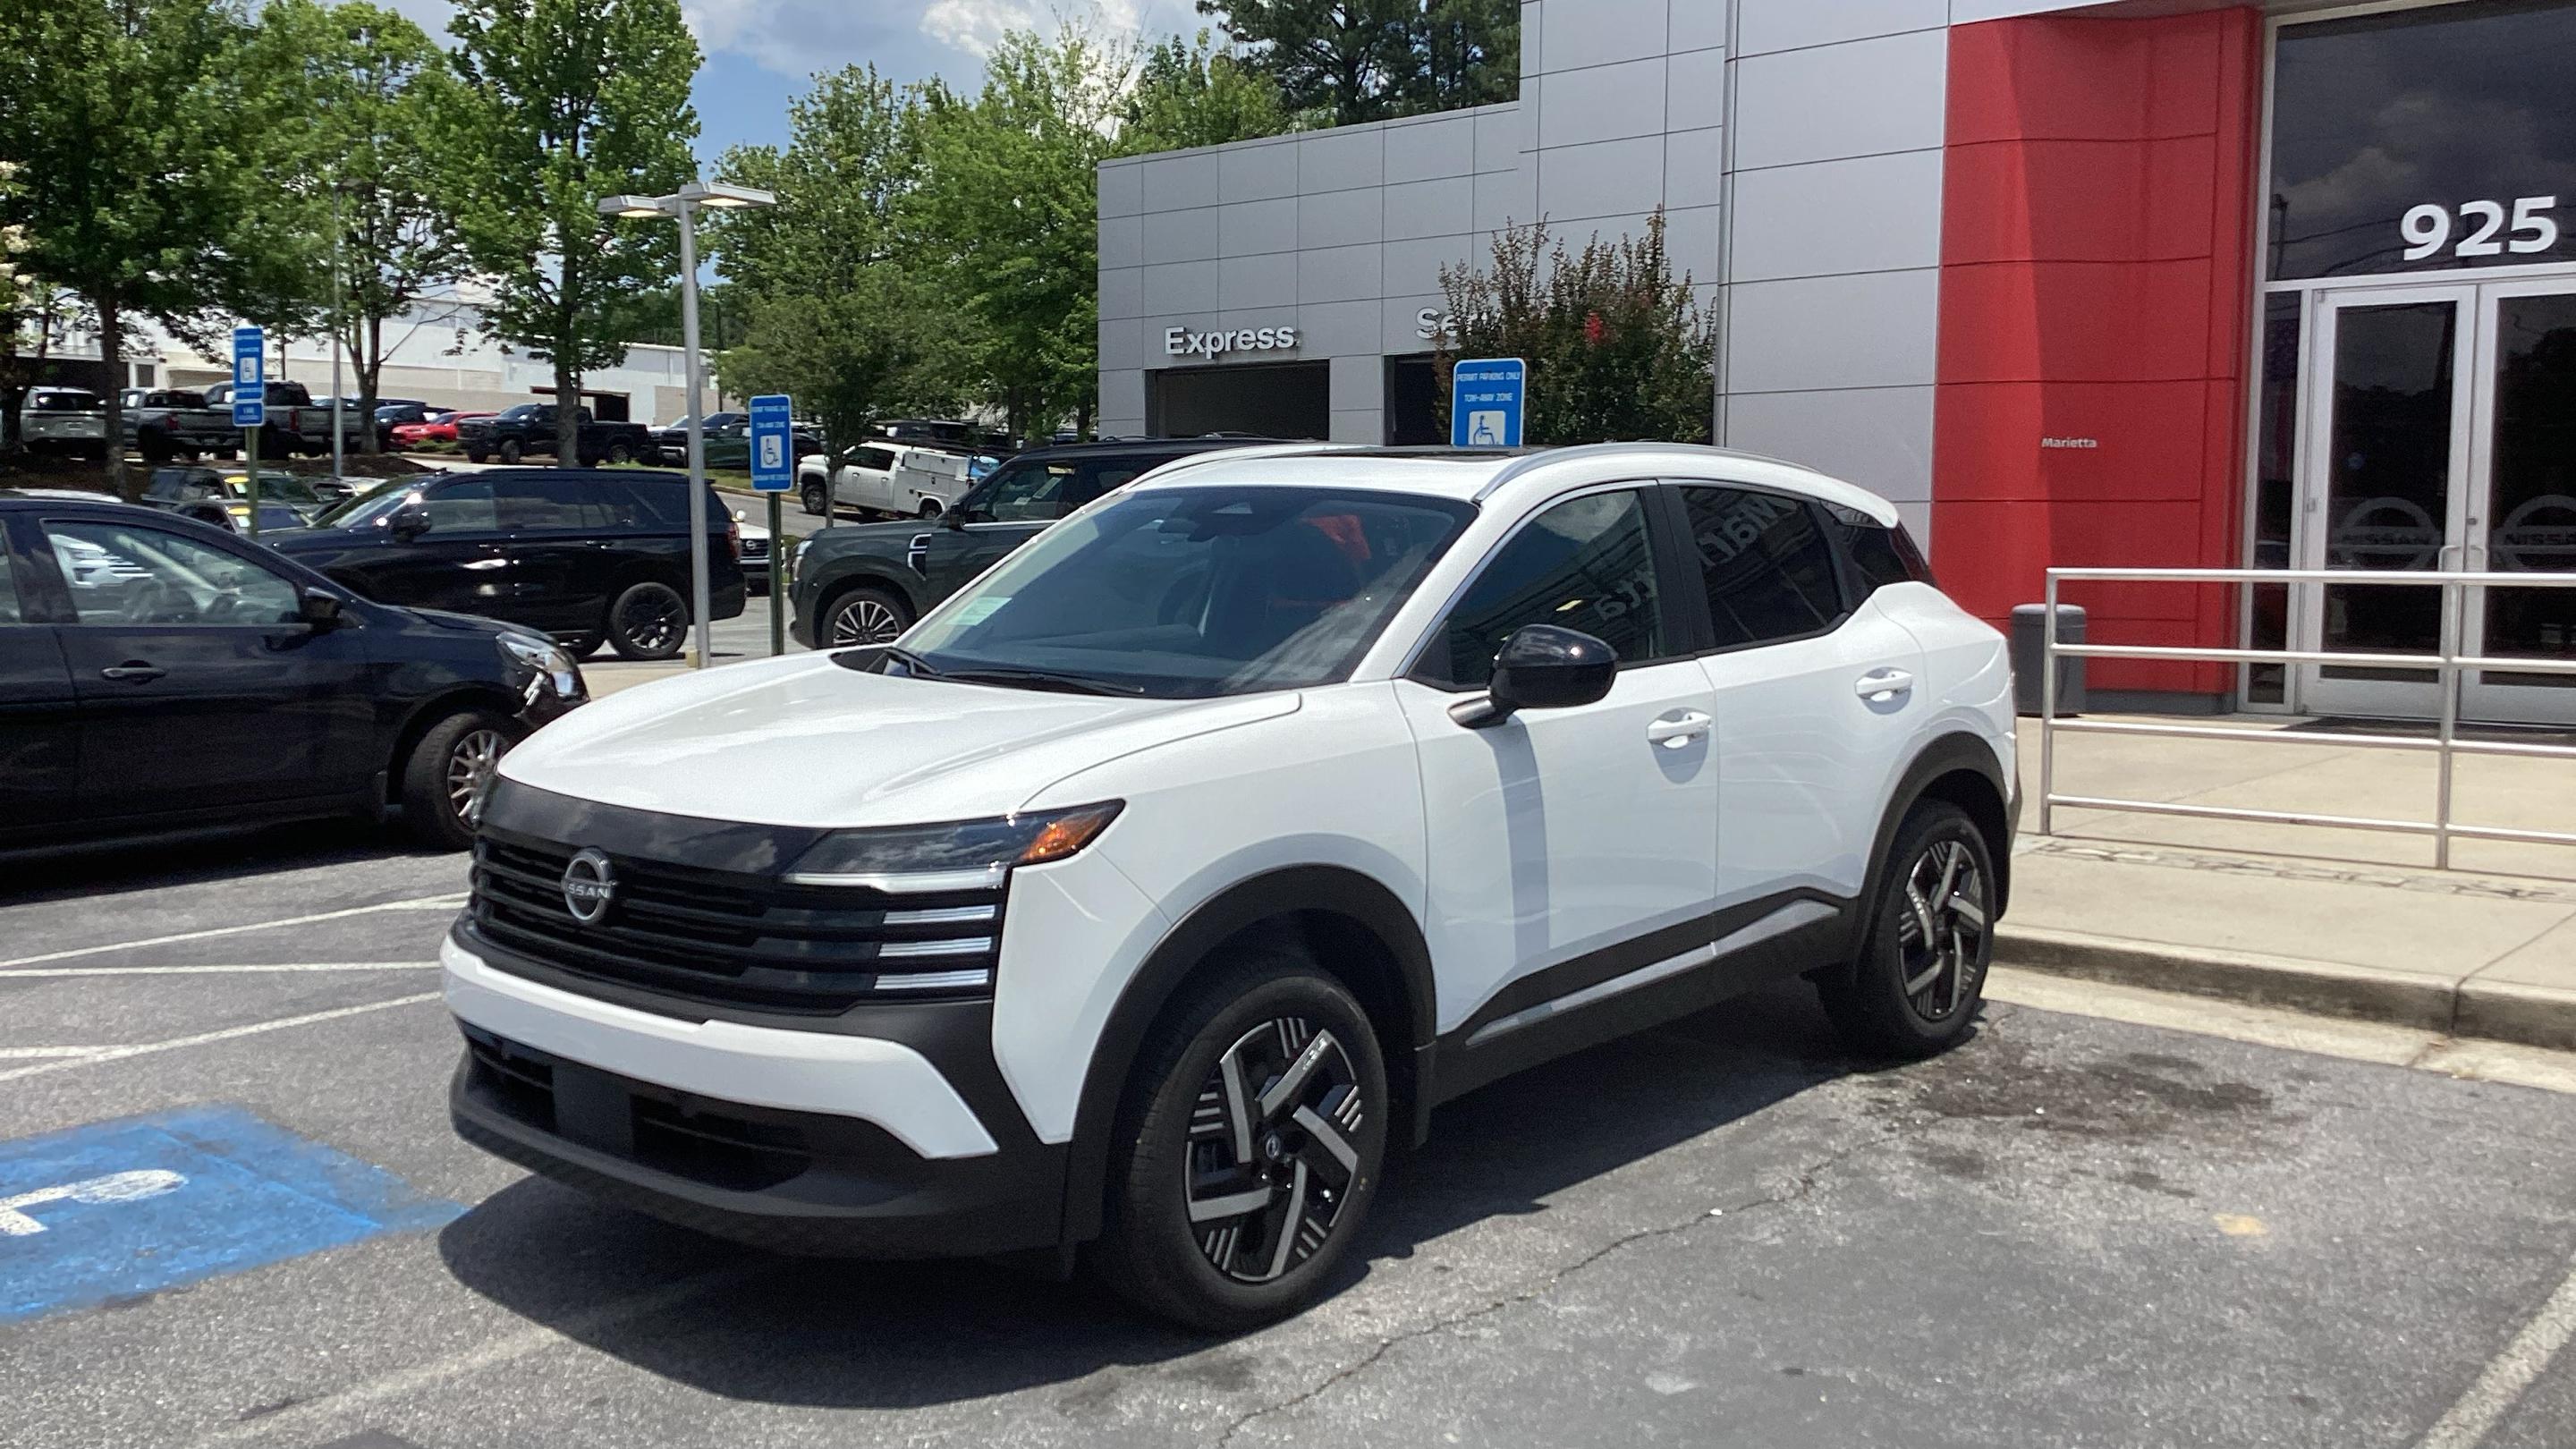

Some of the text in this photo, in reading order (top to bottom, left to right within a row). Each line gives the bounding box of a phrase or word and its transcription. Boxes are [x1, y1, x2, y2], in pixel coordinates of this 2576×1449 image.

[2401, 195, 2557, 261] 925
[1165, 326, 1295, 360] Express
[1506, 371, 1521, 380] ONLY
[1496, 393, 1513, 402] ZONE
[2042, 436, 2097, 448] Marietta
